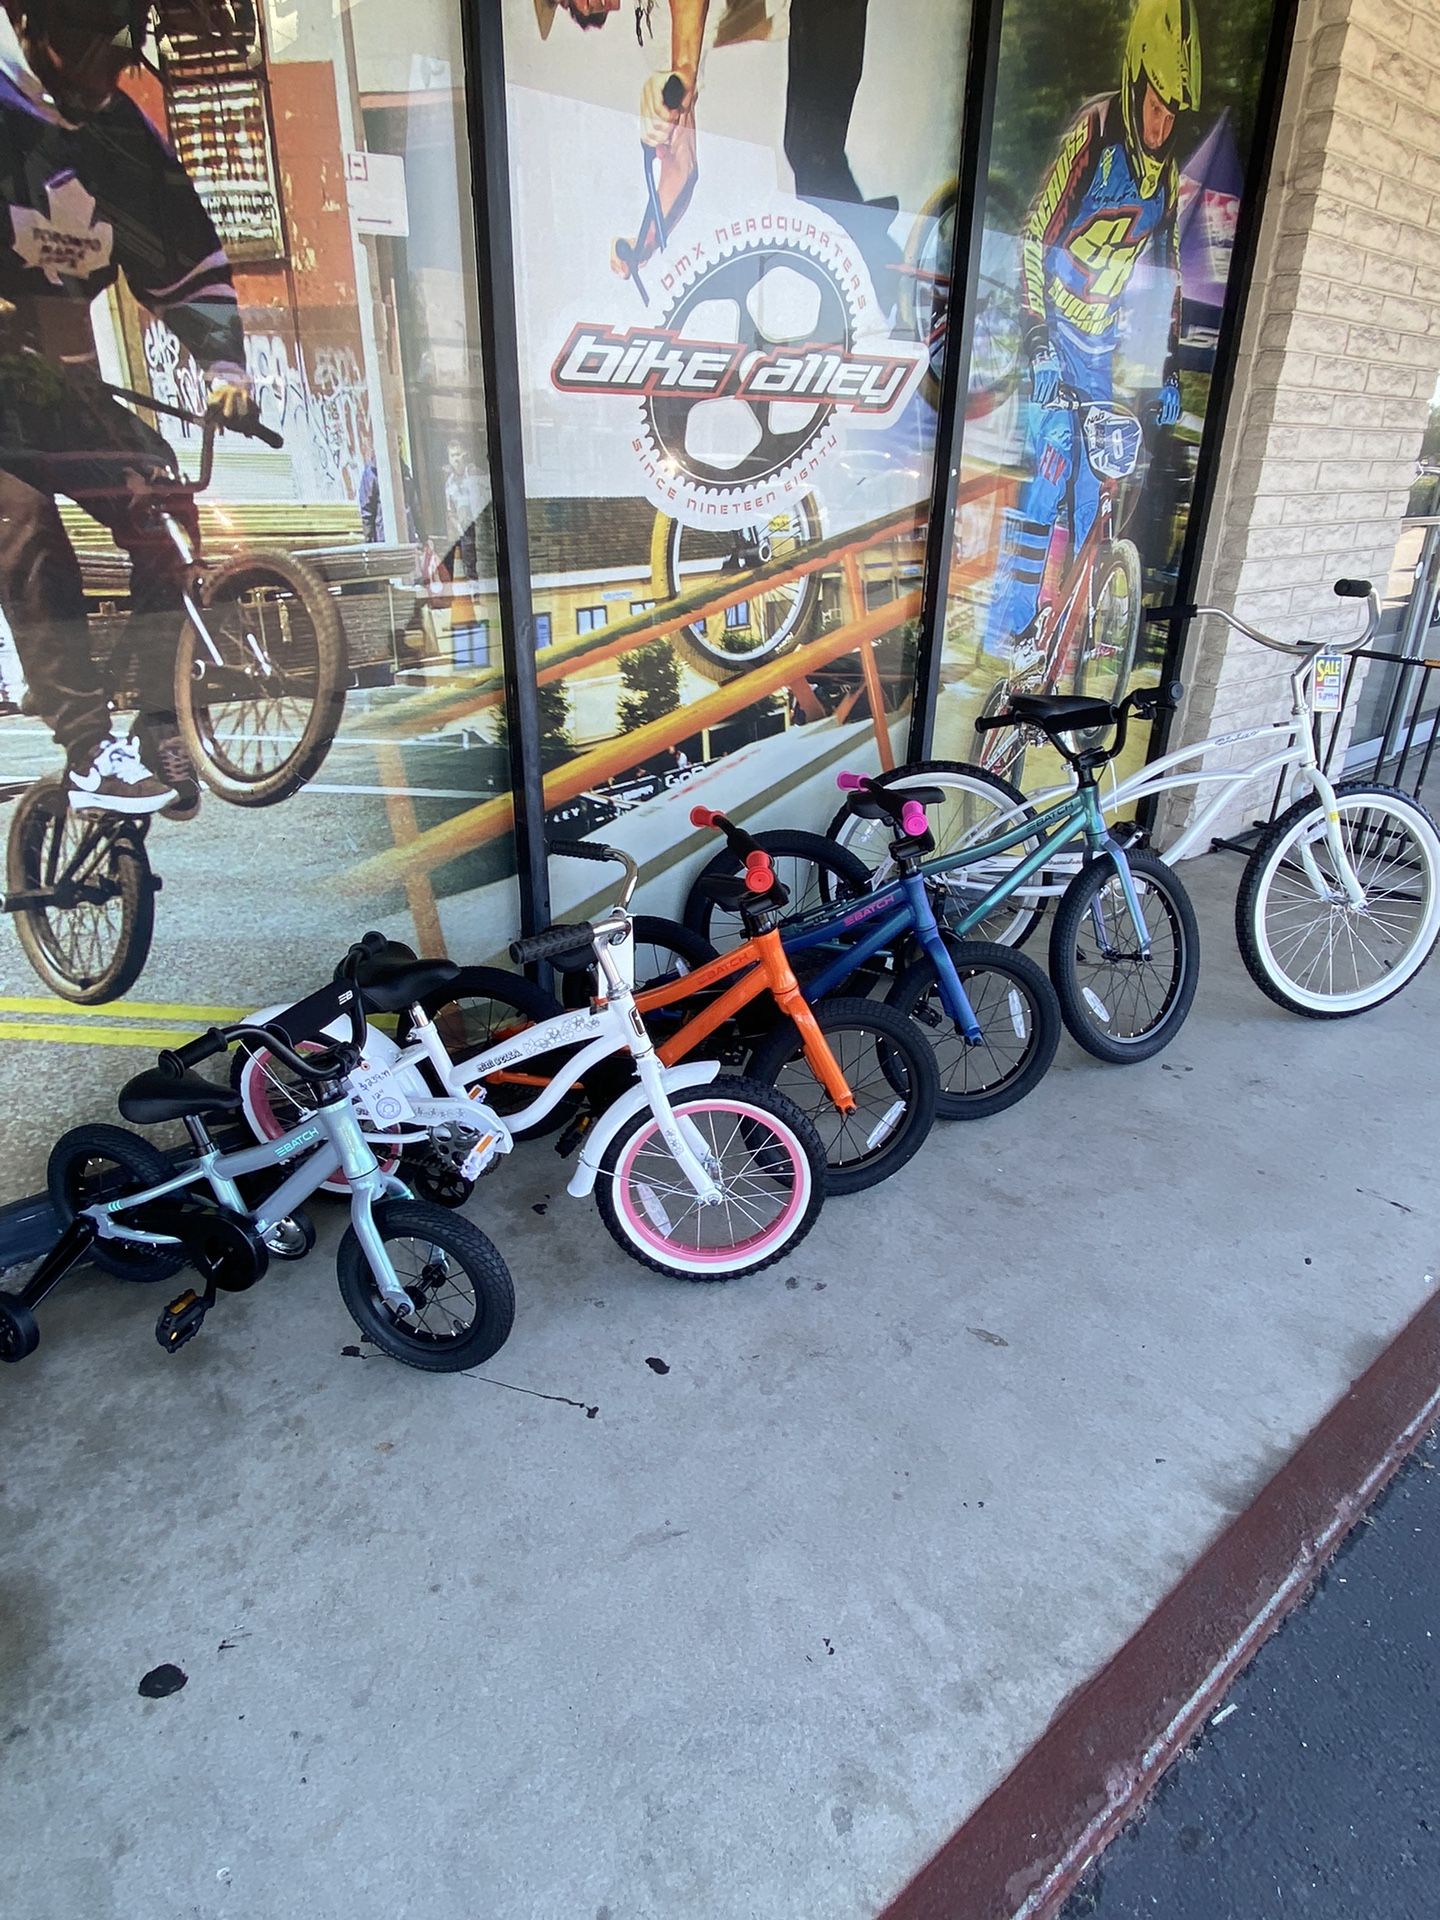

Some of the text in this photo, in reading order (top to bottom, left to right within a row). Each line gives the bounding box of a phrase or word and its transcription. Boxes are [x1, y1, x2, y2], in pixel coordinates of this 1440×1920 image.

[631, 437, 678, 500] SINCE
[686, 491, 776, 515] NINETEEN
[1316, 659, 1341, 682] SALE
[274, 1126, 320, 1158] BATCH
